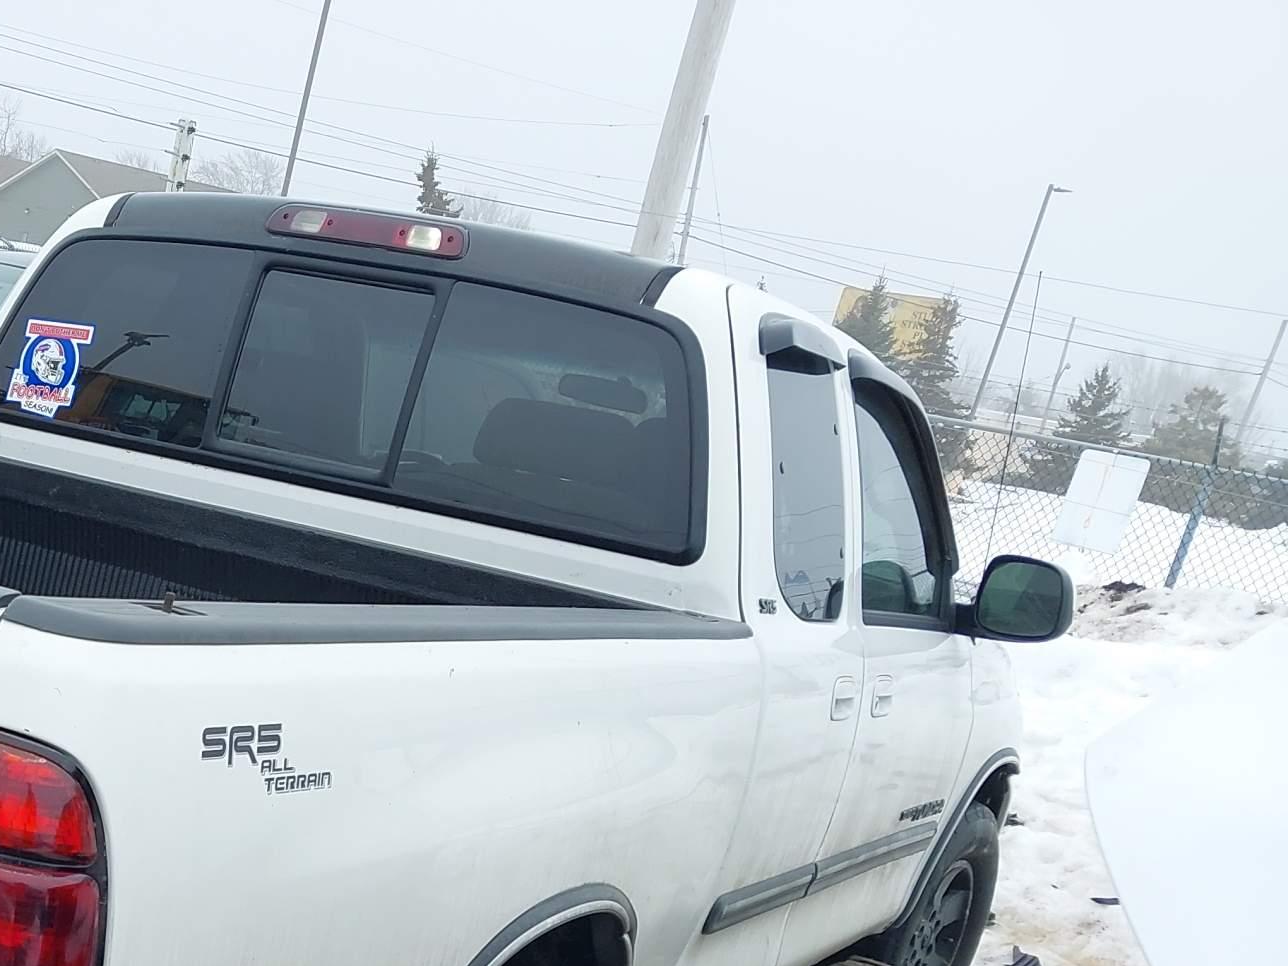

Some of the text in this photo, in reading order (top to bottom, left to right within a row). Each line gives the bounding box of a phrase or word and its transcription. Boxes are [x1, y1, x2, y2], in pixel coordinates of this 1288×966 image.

[10, 382, 70, 403] FOOTBALL
[23, 401, 53, 415] SEASON!
[201, 723, 282, 767] SR5
[260, 758, 295, 774] ALL
[264, 771, 332, 794] TERRAIN
